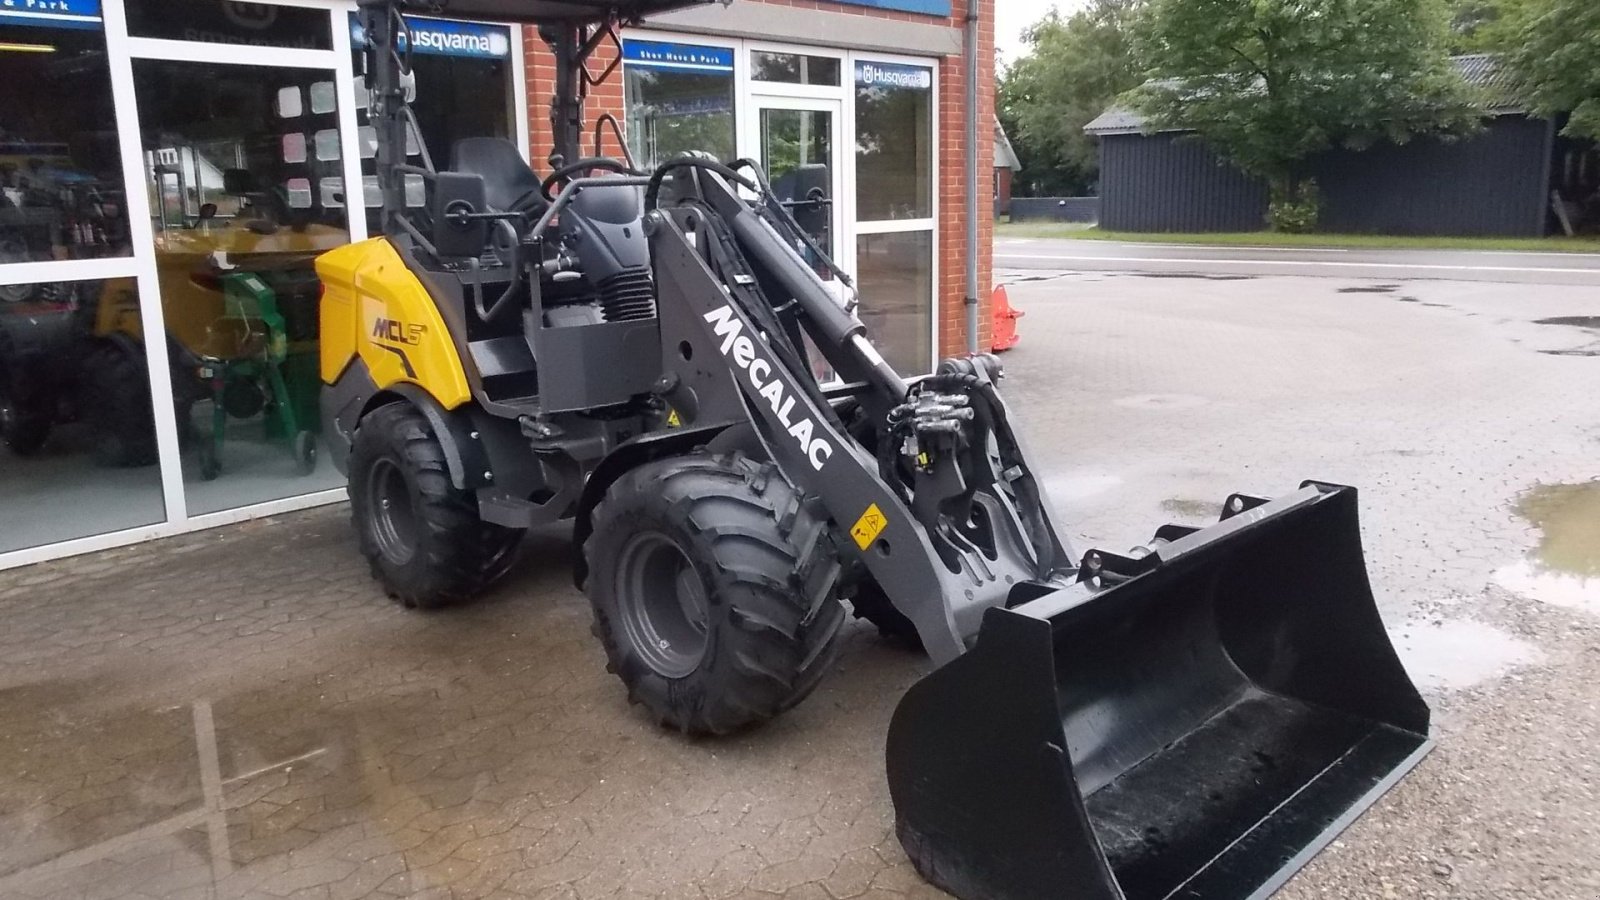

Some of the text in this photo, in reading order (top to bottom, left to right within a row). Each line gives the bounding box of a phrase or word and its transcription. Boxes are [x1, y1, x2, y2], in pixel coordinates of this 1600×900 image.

[26, 0, 69, 11] Park
[690, 54, 696, 62] &
[700, 55, 720, 64] Park
[873, 67, 922, 85] Husqvarna
